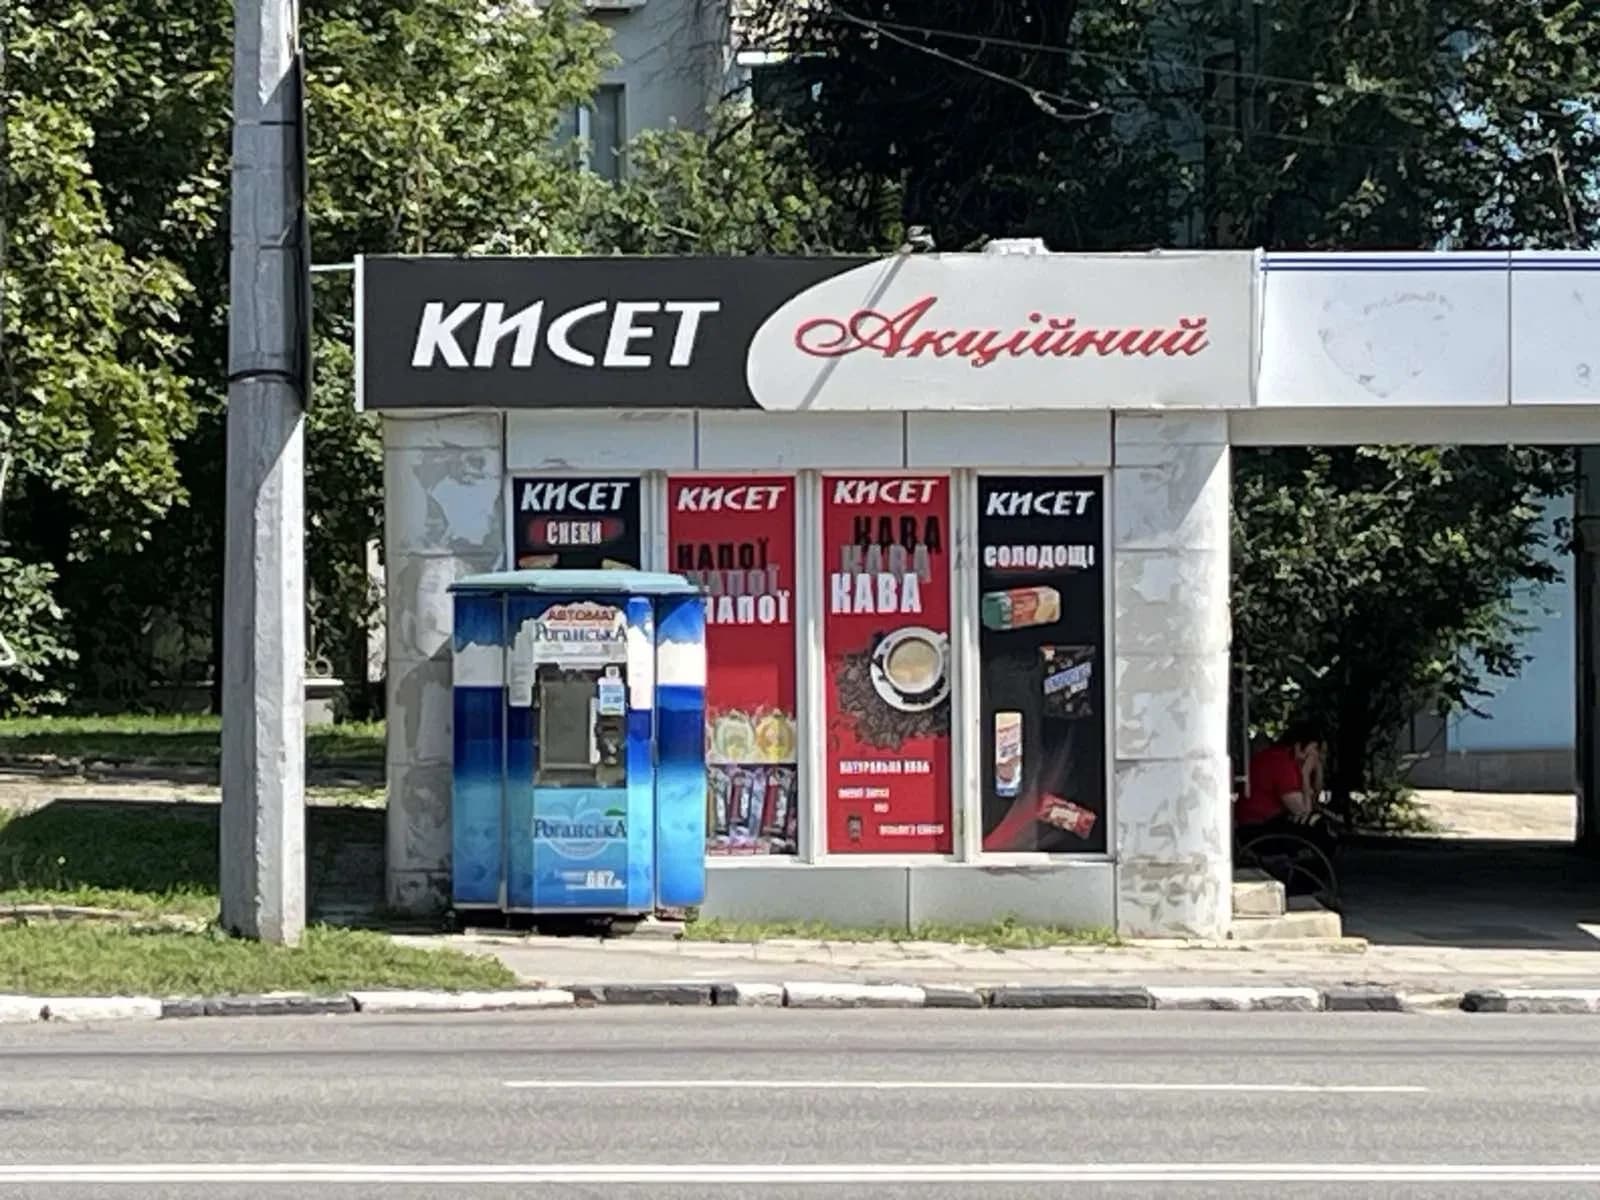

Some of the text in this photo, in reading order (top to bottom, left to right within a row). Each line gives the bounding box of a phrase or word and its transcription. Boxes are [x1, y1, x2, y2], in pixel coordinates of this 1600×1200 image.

[411, 300, 721, 368] КИСЕТ
[795, 296, 1210, 368] Акційний
[520, 481, 631, 512] КИСЕТ
[677, 485, 787, 512] КИСЕТ
[833, 479, 939, 504] КИСЕТ
[985, 490, 1095, 516] КИСЕТ
[854, 515, 942, 554] КАВА
[677, 537, 769, 570] НАПОЇ
[831, 572, 922, 614] КАВА
[547, 609, 616, 621] АВТОМАТ
